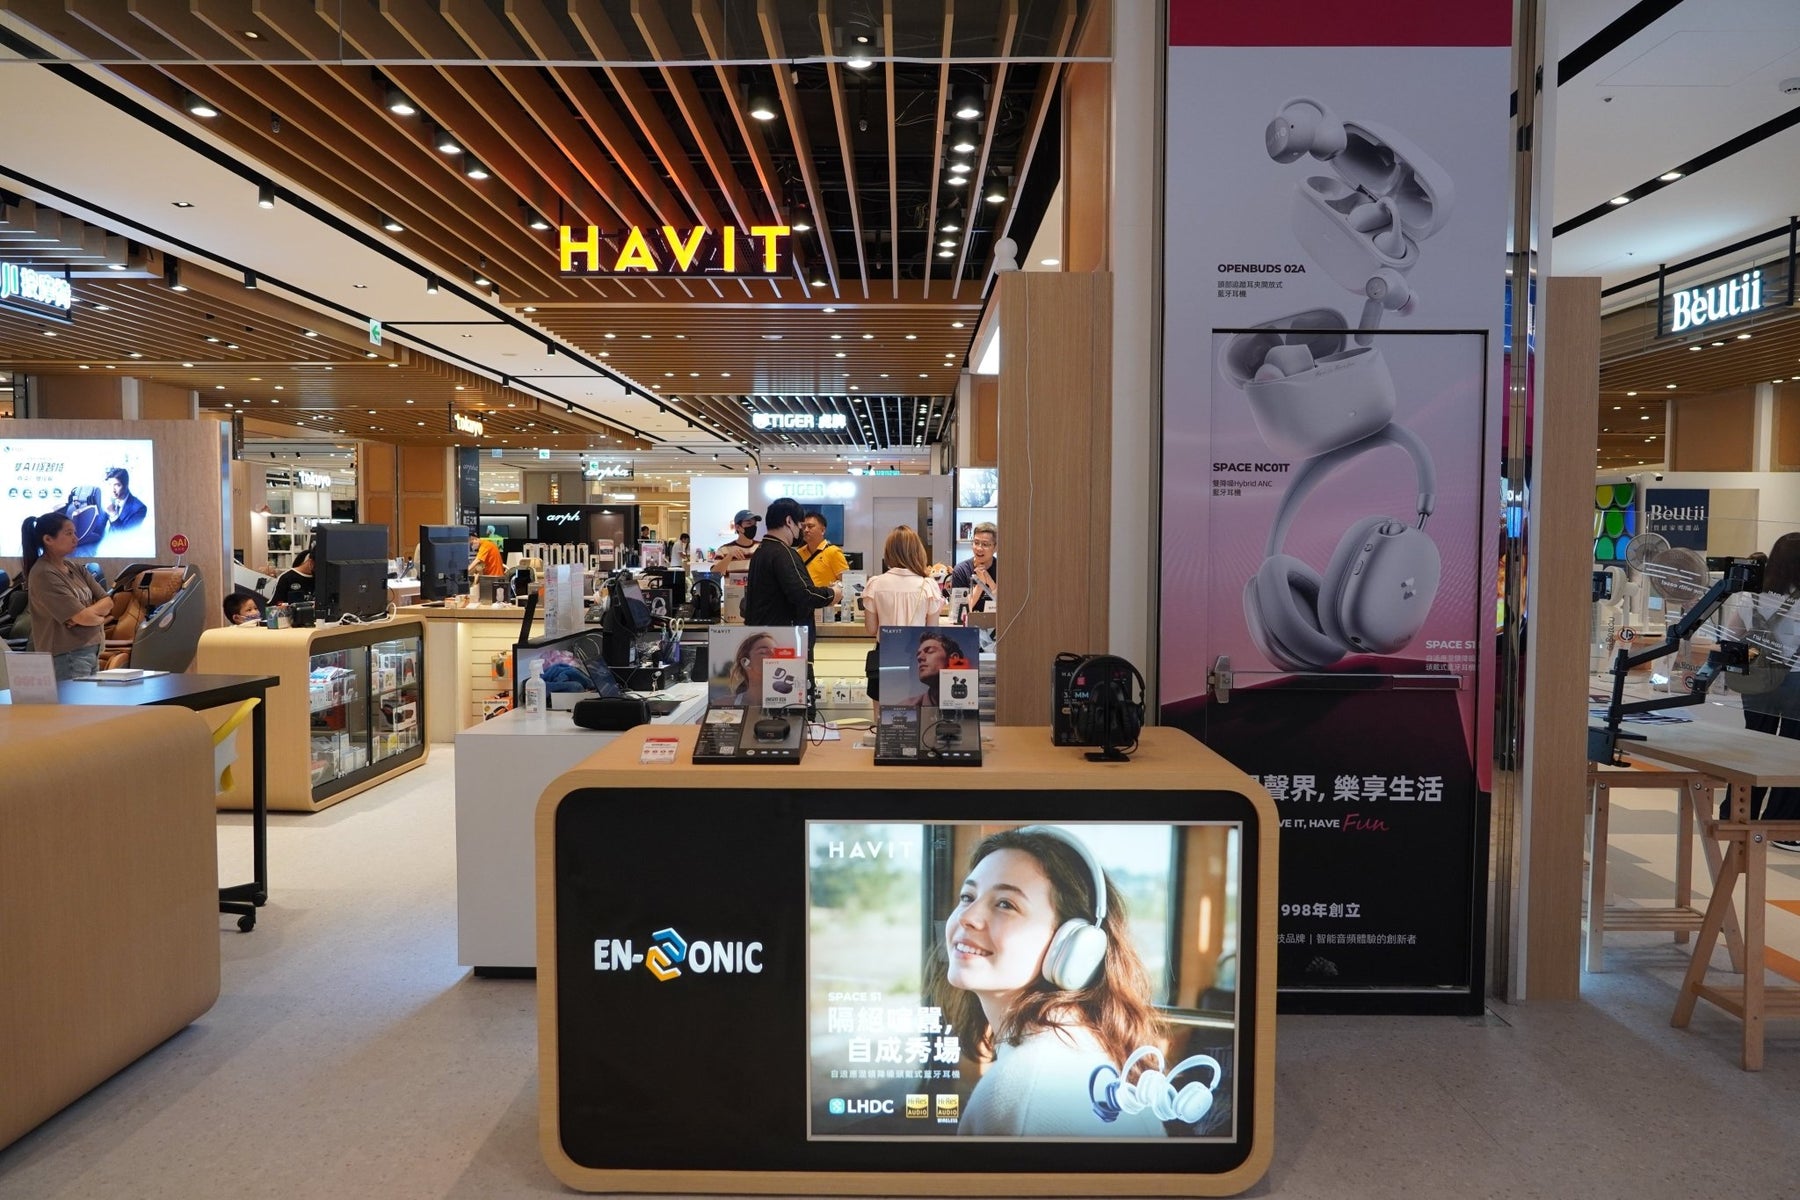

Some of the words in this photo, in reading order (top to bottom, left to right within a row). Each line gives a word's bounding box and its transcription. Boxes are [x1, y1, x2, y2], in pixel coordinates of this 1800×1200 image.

[560, 225, 791, 273] HAVIT
[1217, 263, 1282, 274] OPENBUDS
[1284, 264, 1306, 274] 02A
[771, 413, 815, 428] TIGER
[1212, 462, 1252, 473] SPACE
[1254, 462, 1291, 473] NC01T
[782, 483, 824, 497] TIGER
[1258, 480, 1273, 488] ANC
[1425, 640, 1463, 650] SPACE
[1333, 774, 1445, 803] 樂享生活
[1294, 819, 1307, 830] IT,
[1309, 819, 1340, 828] HAVE
[1341, 812, 1390, 833] Fun
[829, 840, 914, 860] HAVIT
[1280, 902, 1361, 919] 998年創立
[828, 991, 868, 1002] SPACE
[870, 991, 882, 1002] S1
[848, 1036, 962, 1064] 自成秀場
[847, 1098, 895, 1114] LHDC
[907, 1108, 928, 1117] AUDIO
[937, 1108, 959, 1117] AUDIO
